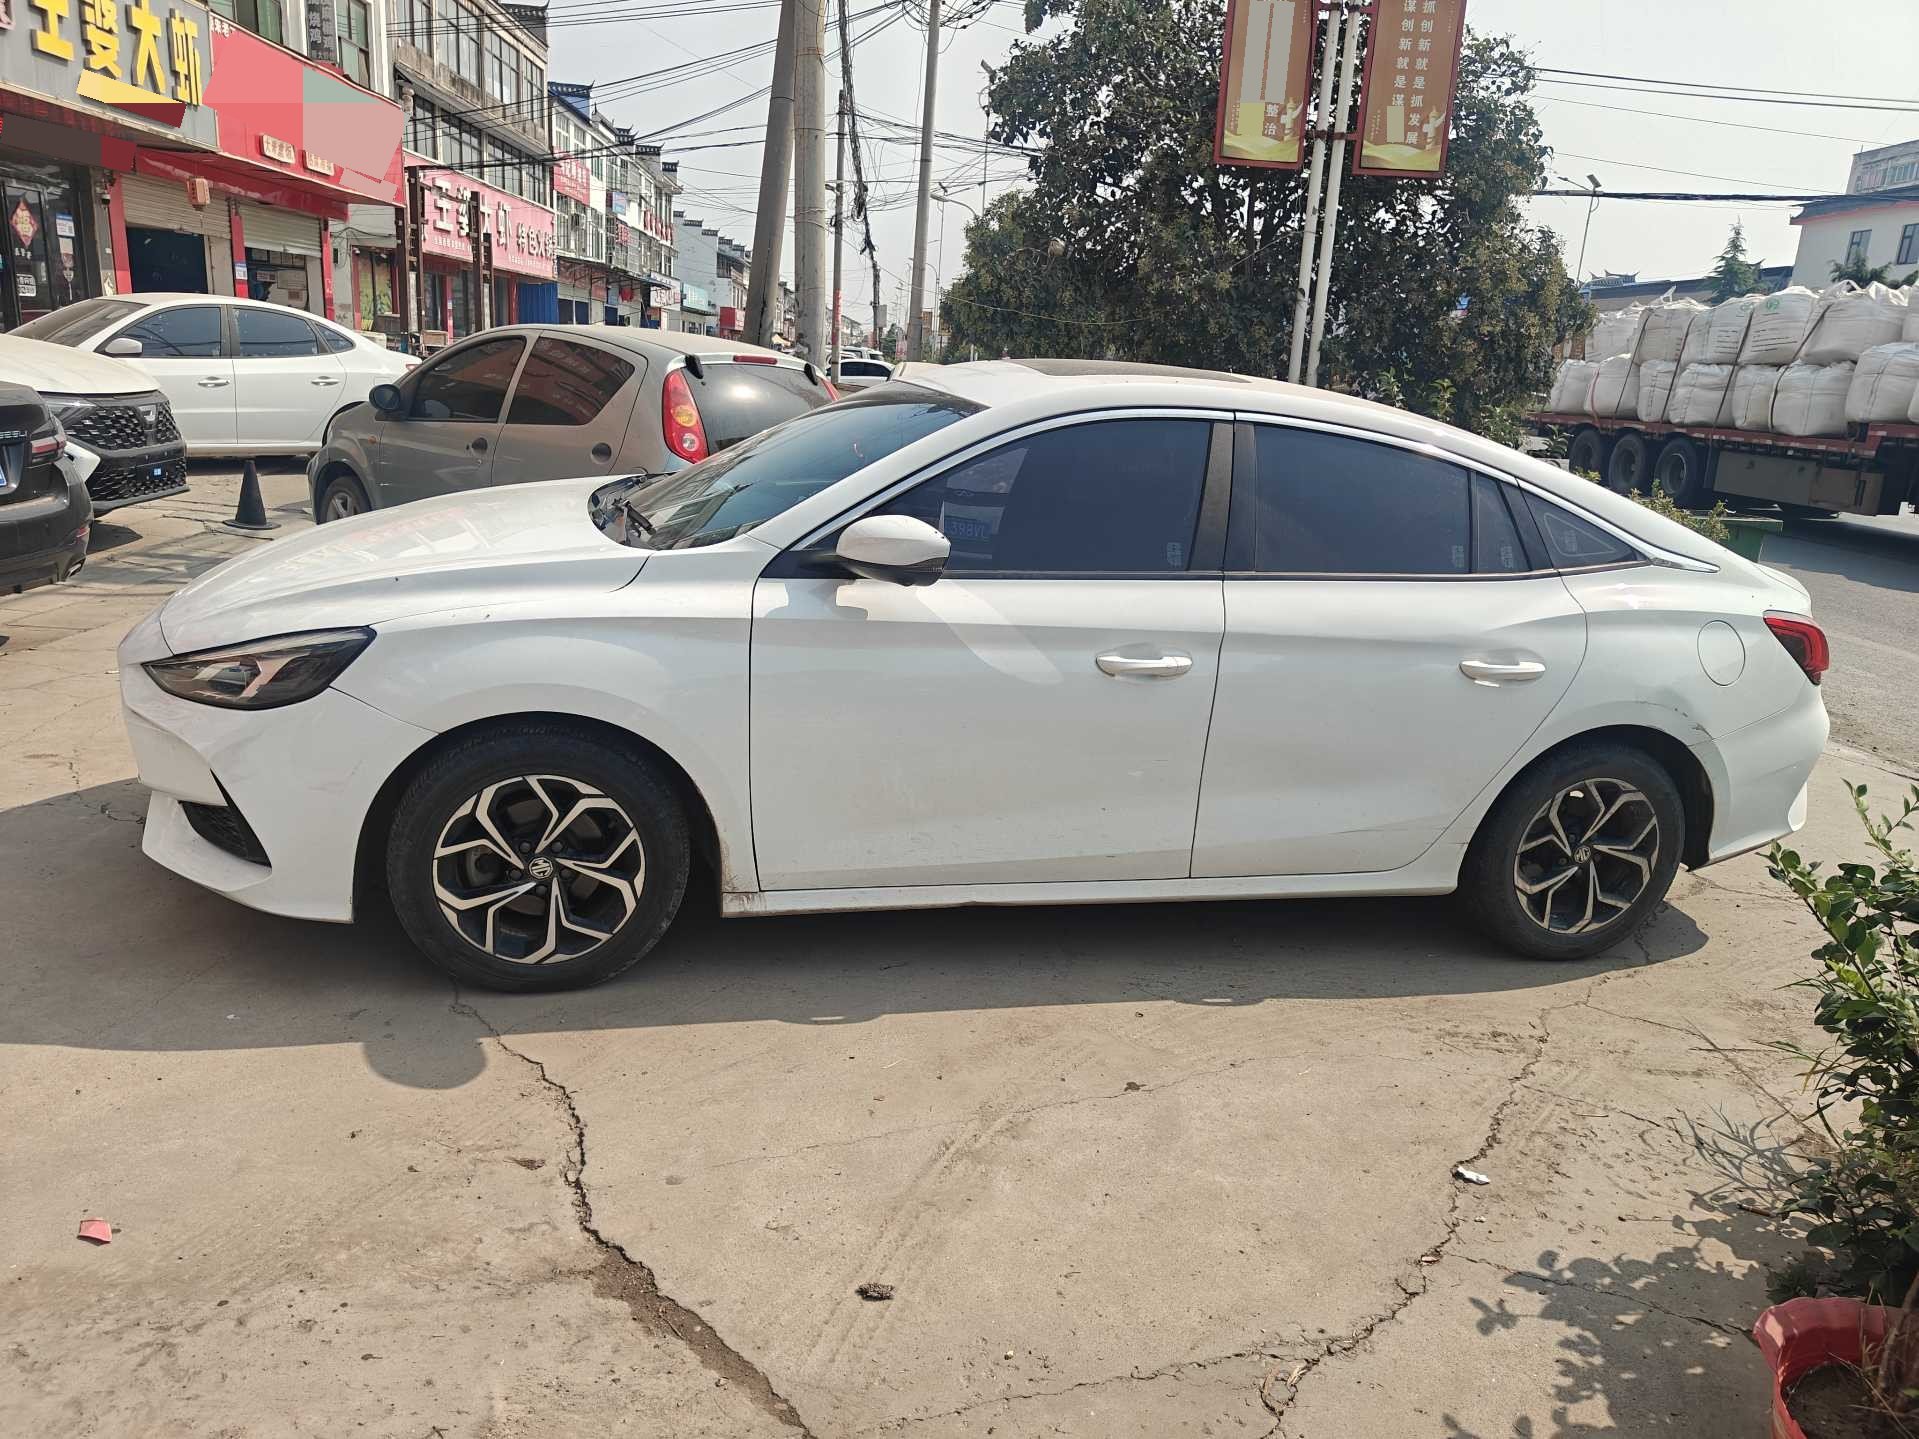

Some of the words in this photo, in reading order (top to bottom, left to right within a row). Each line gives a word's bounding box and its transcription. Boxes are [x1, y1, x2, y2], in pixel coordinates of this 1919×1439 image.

[1405, 0, 1438, 145] 抓创新就是抓发展
